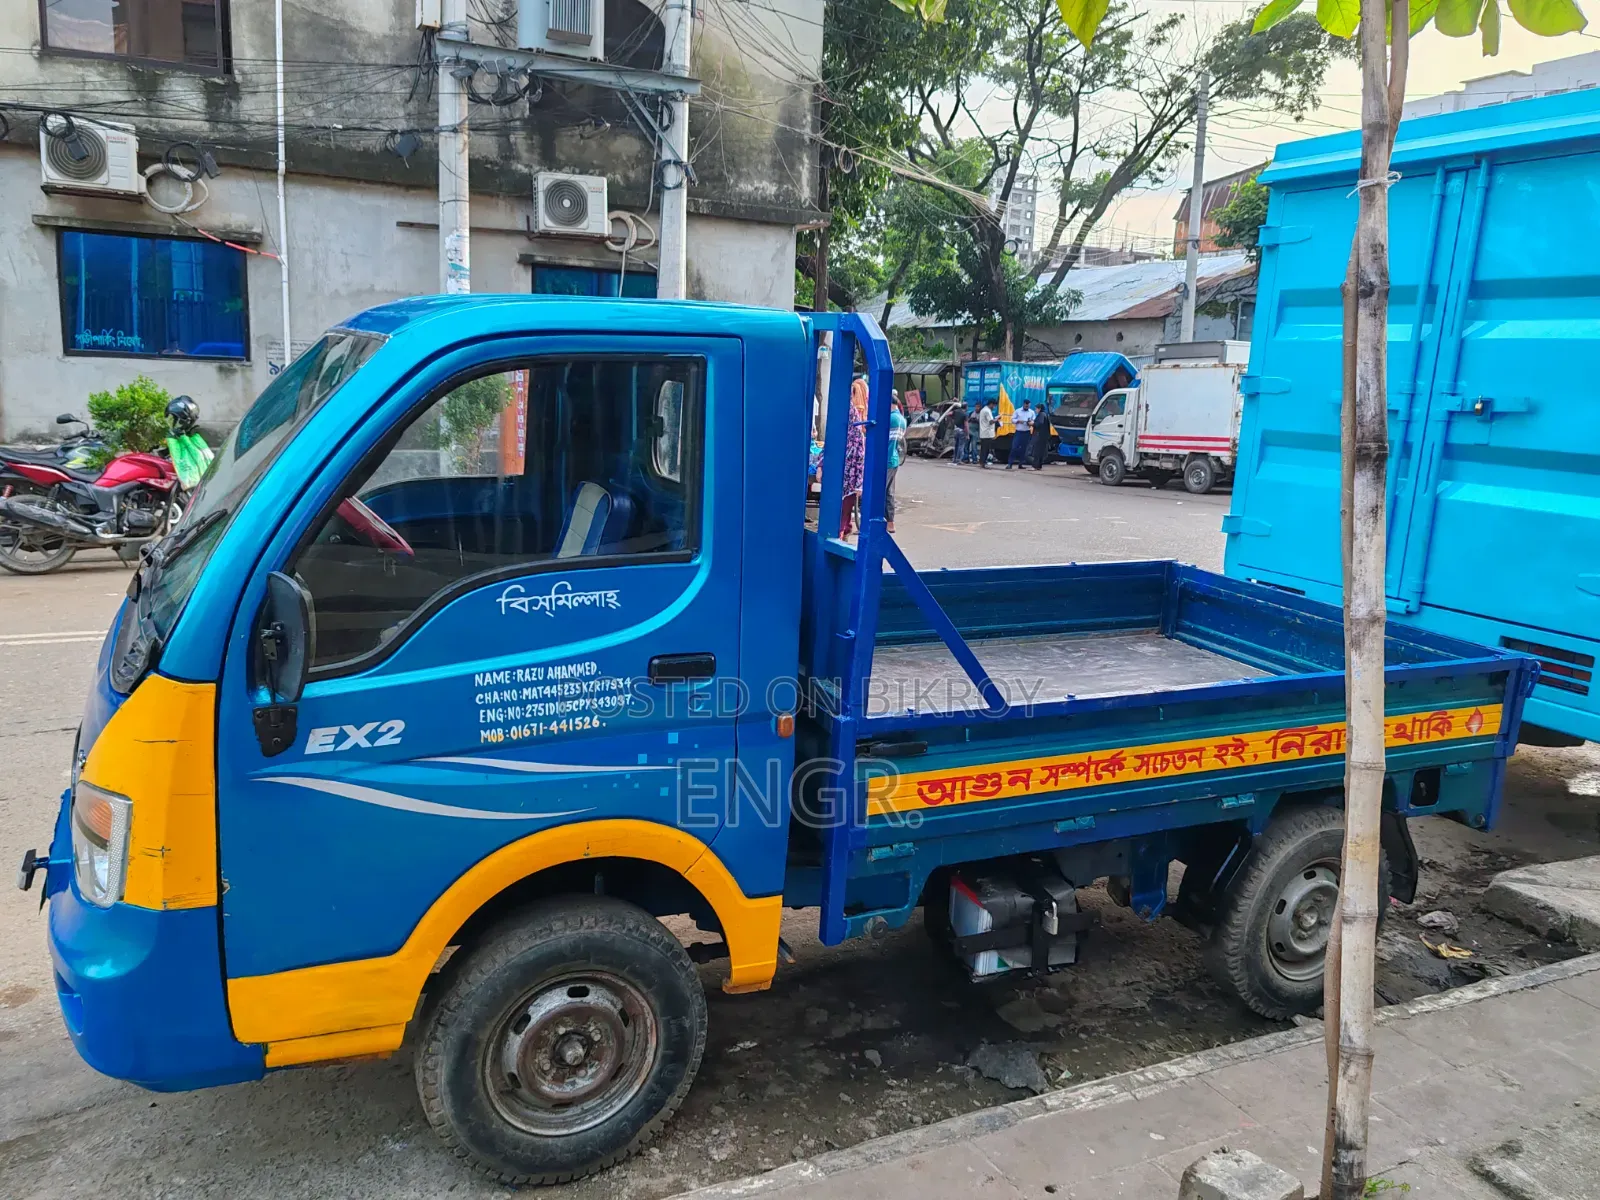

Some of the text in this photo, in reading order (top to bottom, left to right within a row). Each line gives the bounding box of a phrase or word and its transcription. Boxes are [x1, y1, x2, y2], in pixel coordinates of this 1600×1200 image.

[547, 661, 602, 681] AHAMMED.
[304, 719, 405, 754] EX2
[917, 768, 1033, 805] আগুন
[1040, 750, 1127, 786] সম্পর্কে
[1134, 747, 1206, 775] সচেতন
[1393, 711, 1454, 742] থাকি
